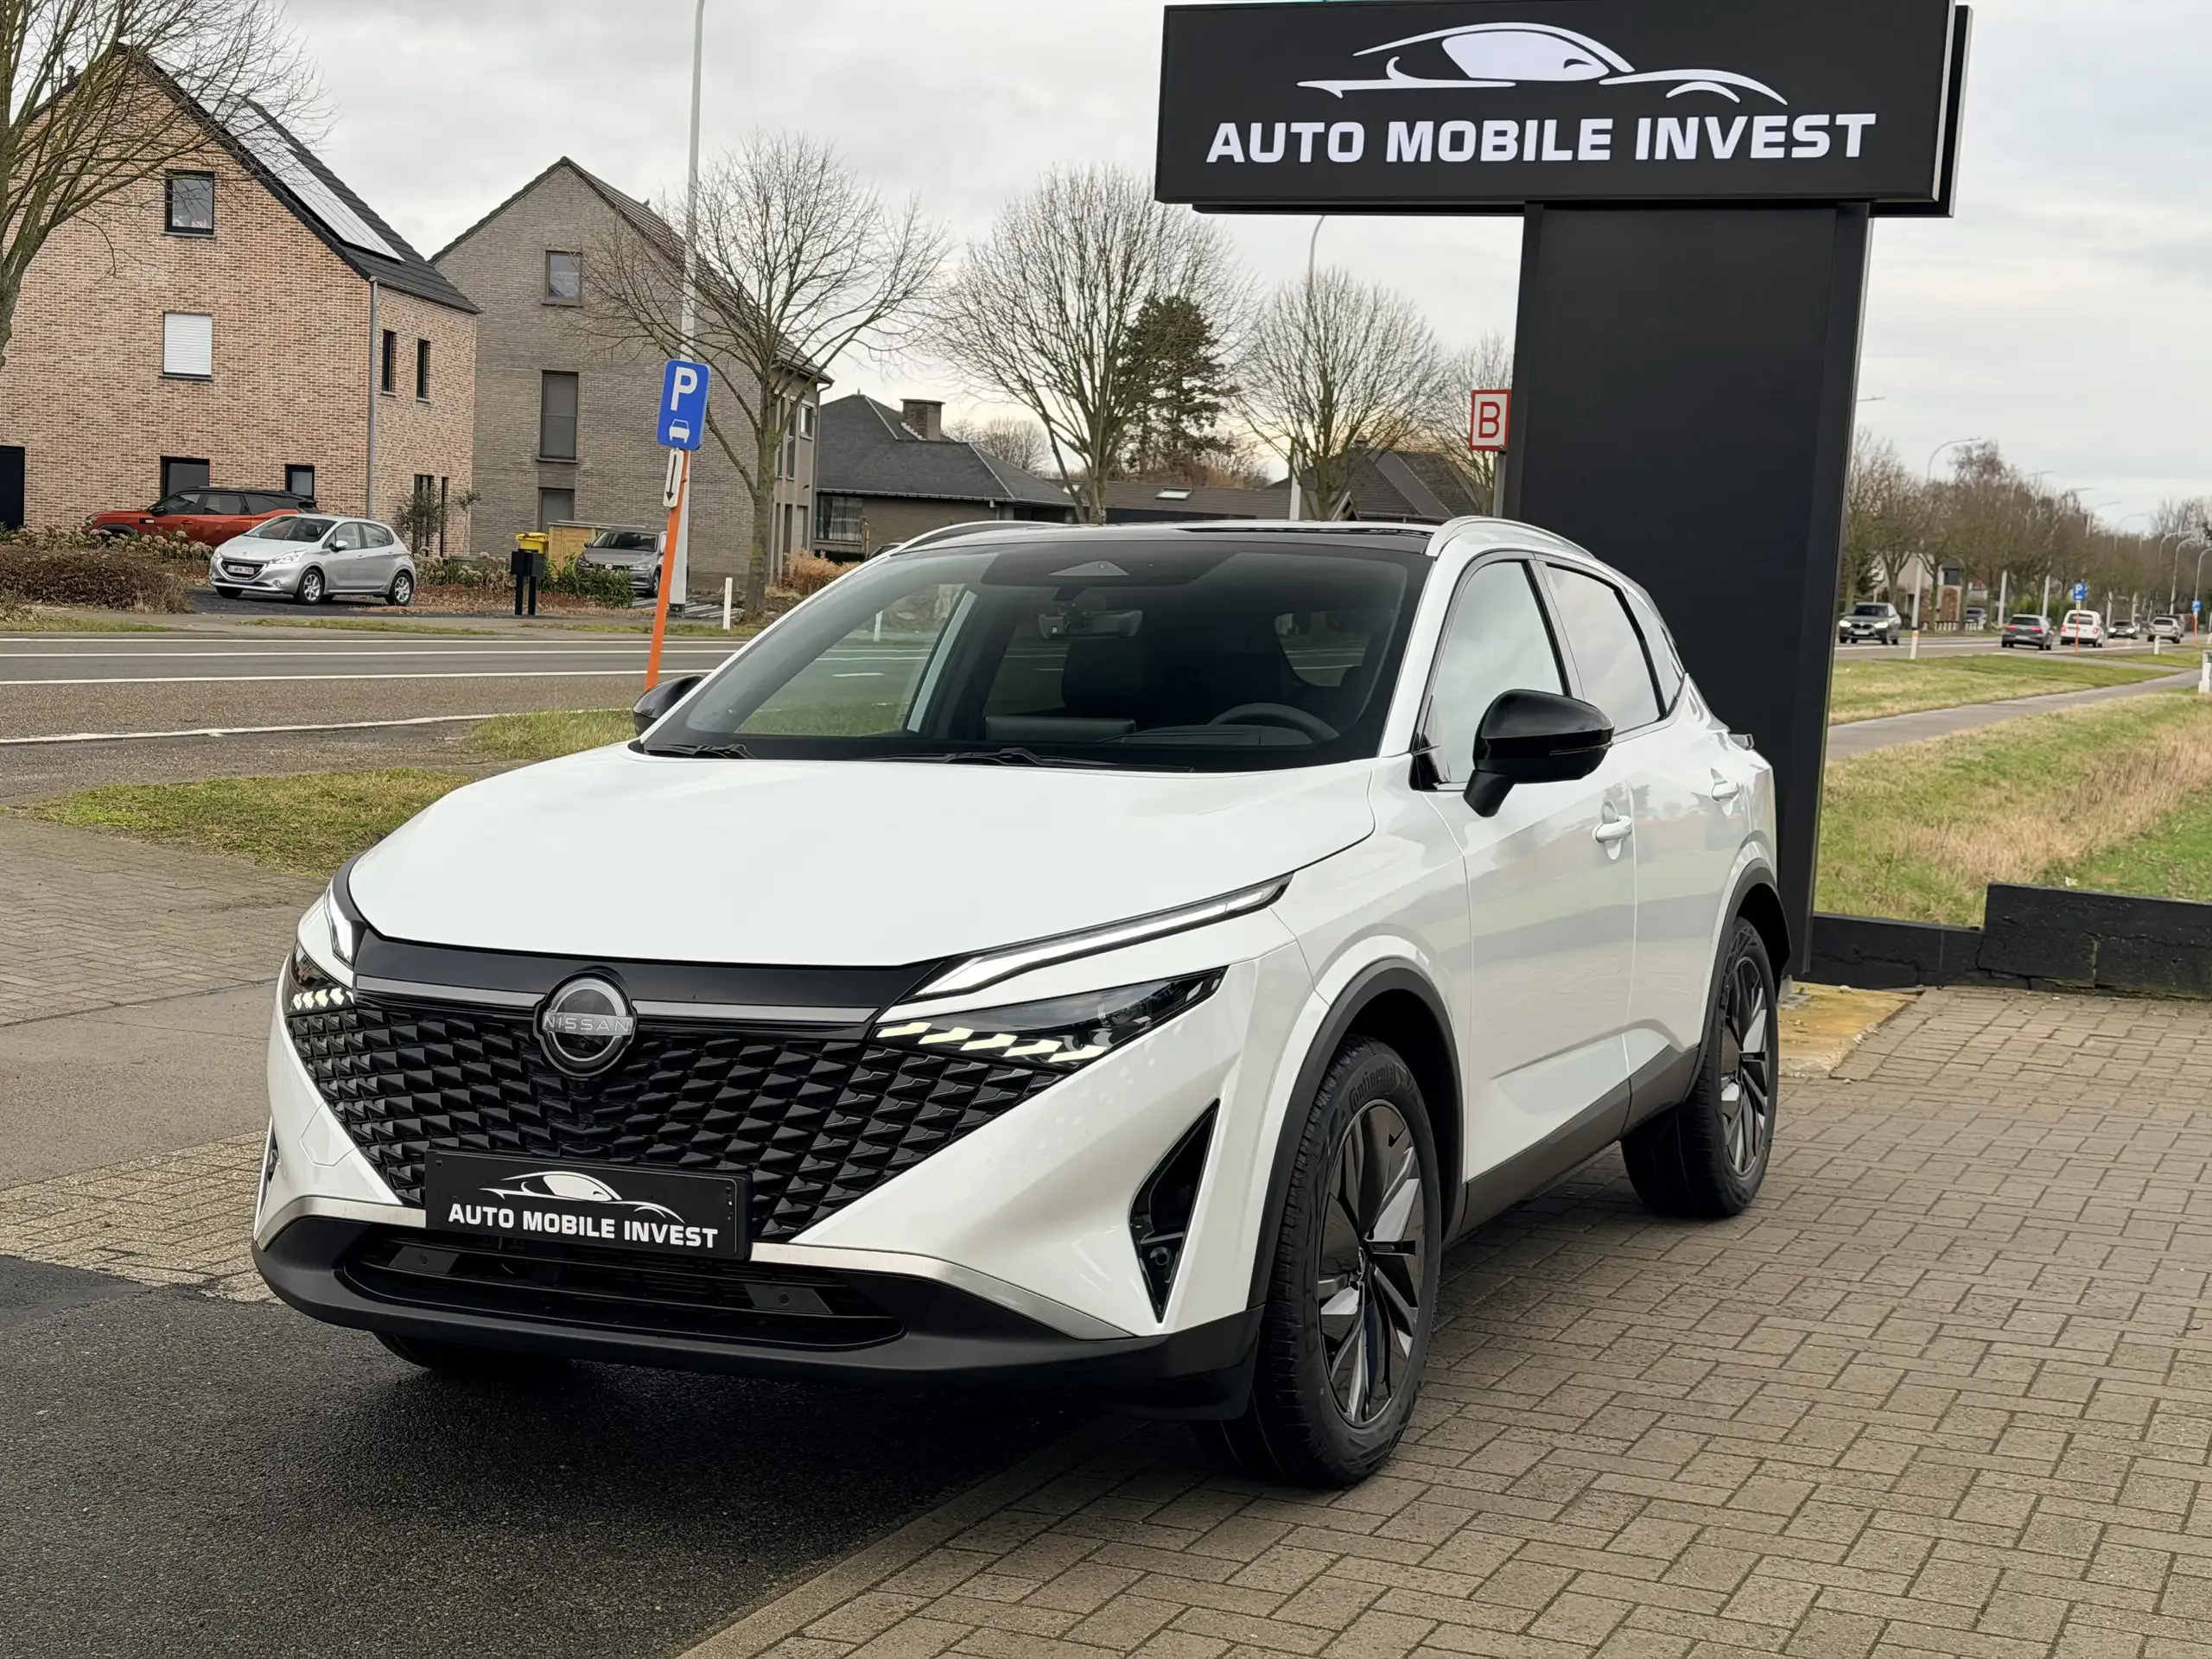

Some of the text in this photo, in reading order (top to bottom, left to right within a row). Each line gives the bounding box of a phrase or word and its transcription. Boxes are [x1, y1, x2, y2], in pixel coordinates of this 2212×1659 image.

[1206, 113, 1877, 163] AUTO MOBILE INVEST
[671, 366, 698, 411] P
[1478, 401, 1501, 439] B
[543, 1016, 630, 1033] NISSAN
[448, 1203, 719, 1249] AUTO MOBILE INVEST
